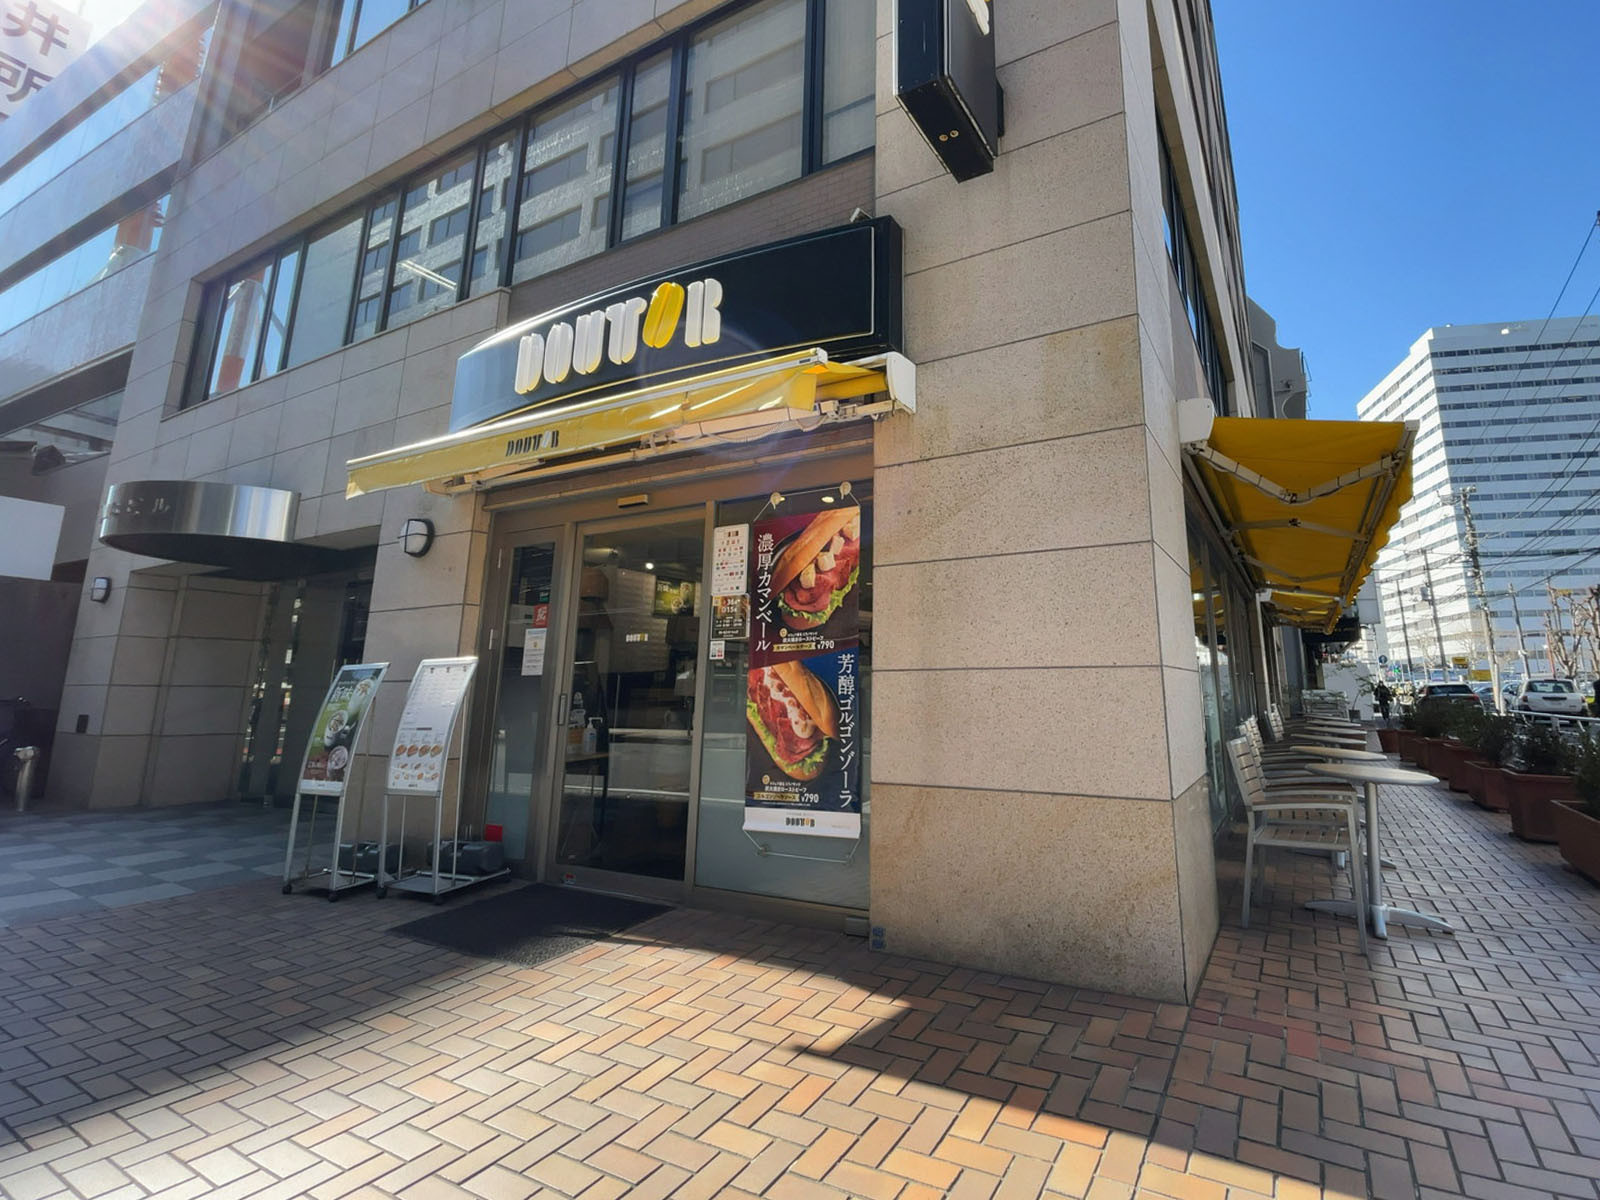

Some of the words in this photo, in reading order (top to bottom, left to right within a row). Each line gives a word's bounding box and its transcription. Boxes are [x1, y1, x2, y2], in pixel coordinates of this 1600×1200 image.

[514, 278, 723, 395] DOUTOR
[505, 430, 560, 457] DOUTOR
[756, 533, 774, 652] 濃厚カマンベール
[837, 653, 856, 809] 芳醇ゴルゴンゾーラ
[785, 816, 816, 828] DOUTOR
